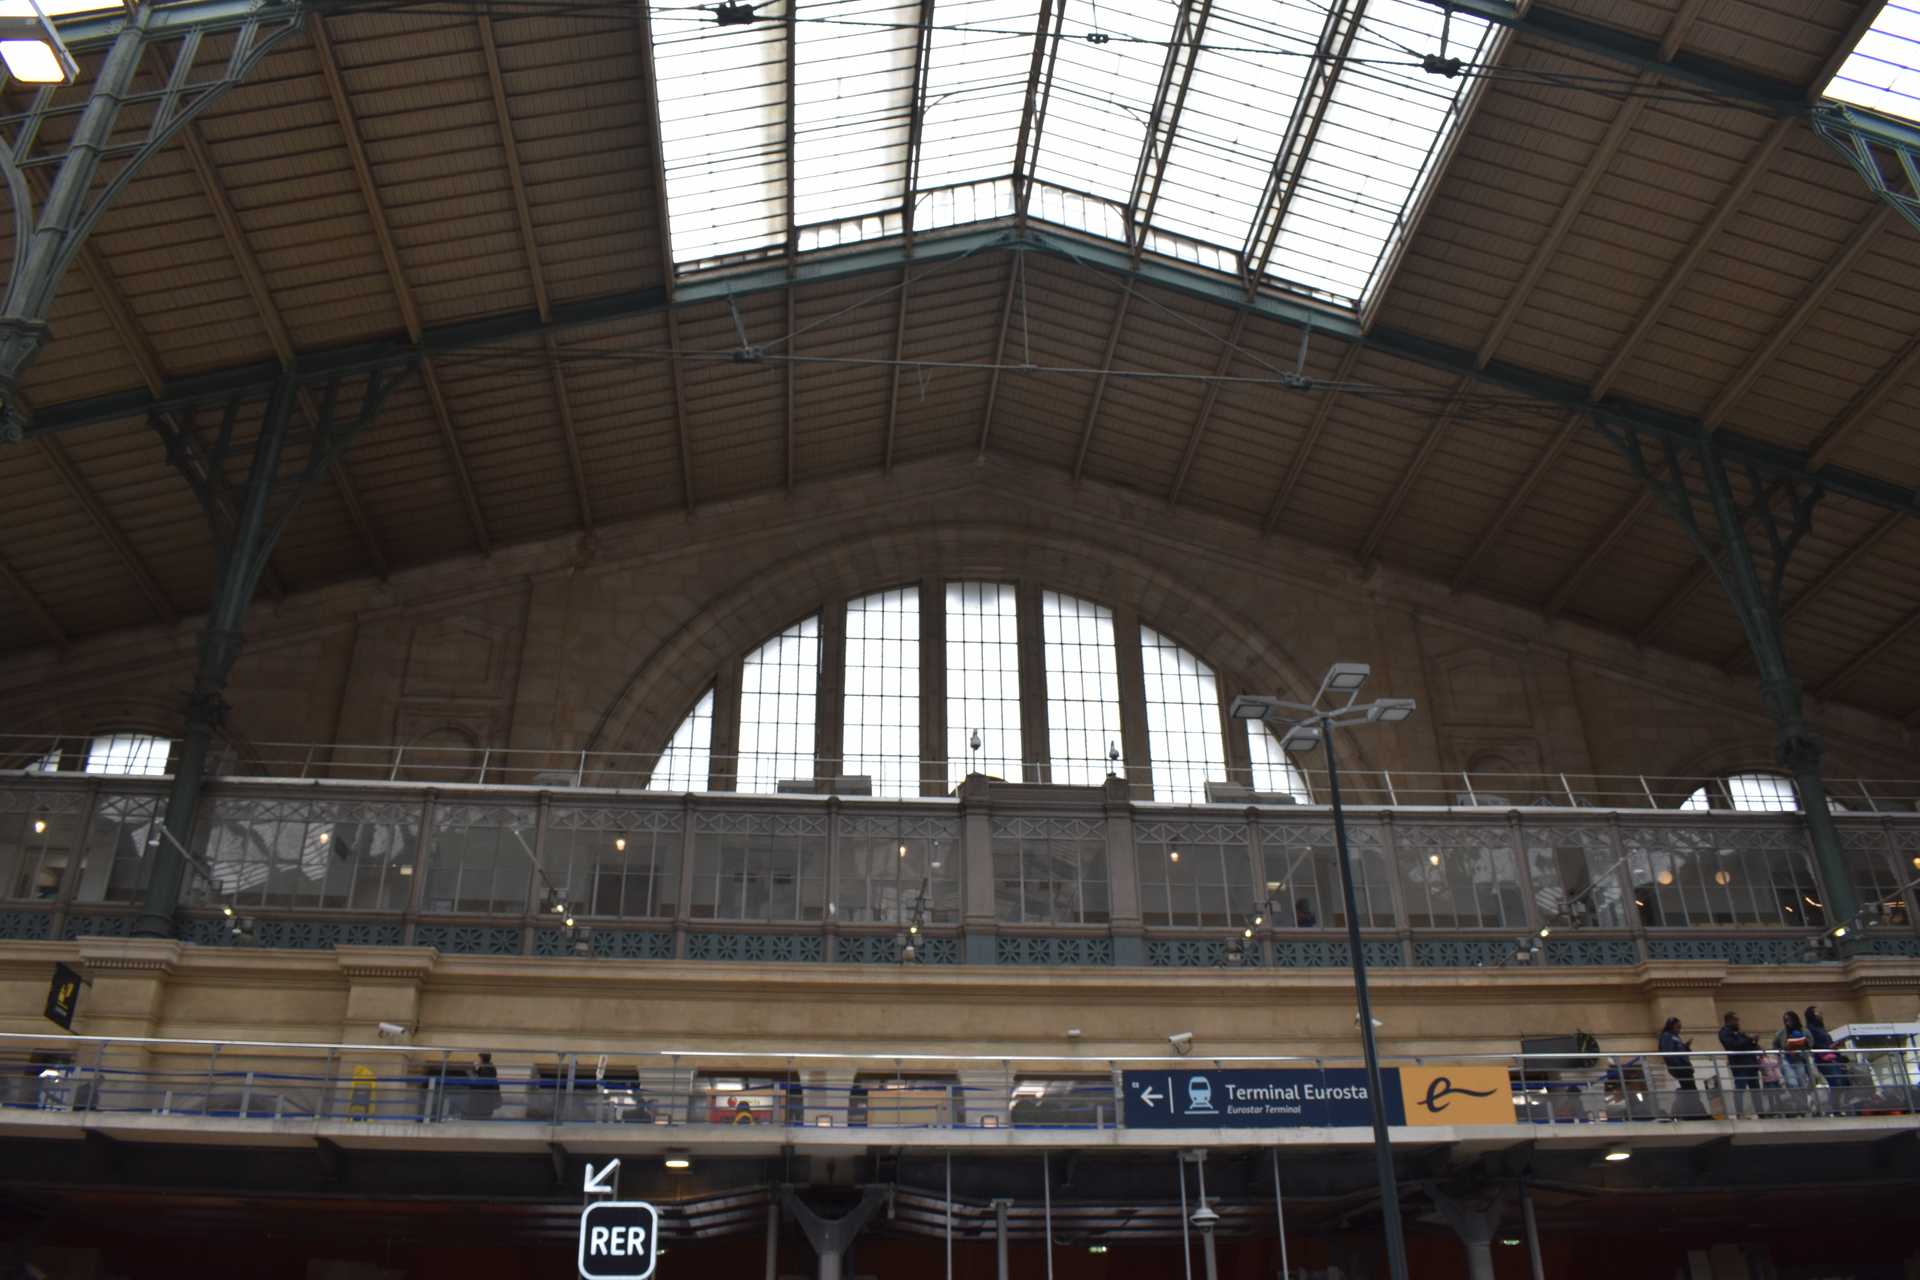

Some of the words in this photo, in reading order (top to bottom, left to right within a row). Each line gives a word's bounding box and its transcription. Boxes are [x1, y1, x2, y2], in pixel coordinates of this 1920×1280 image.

[1225, 1083, 1300, 1100] Terminal
[1303, 1083, 1368, 1100] Eurosta
[1227, 1104, 1263, 1114] Eurostar
[1265, 1103, 1302, 1114] Terminal
[590, 1225, 646, 1256] RER
